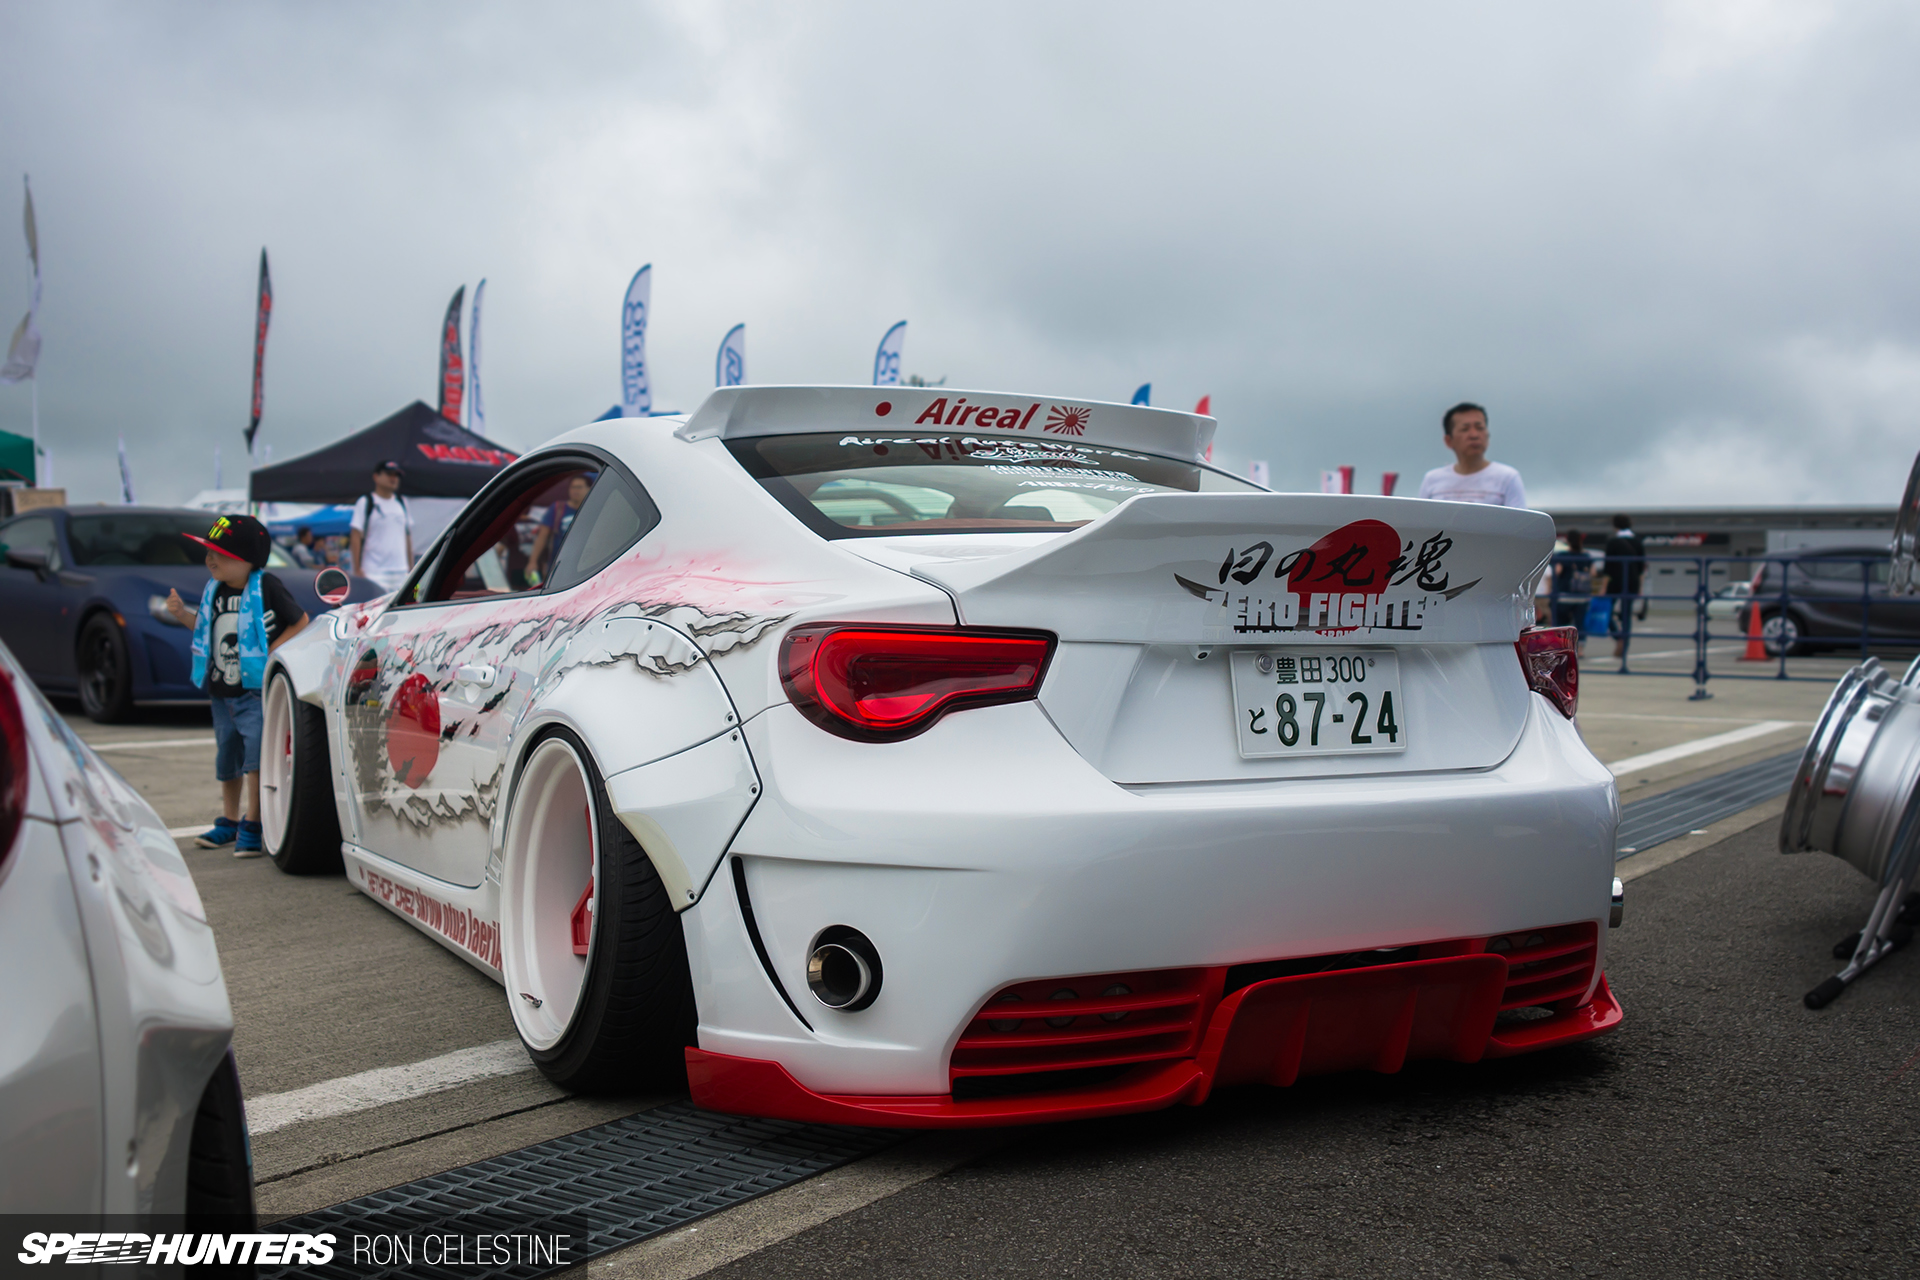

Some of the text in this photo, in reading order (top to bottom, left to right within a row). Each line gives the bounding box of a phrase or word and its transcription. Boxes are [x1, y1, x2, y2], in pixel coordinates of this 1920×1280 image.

[915, 398, 1041, 430] Aireal
[1218, 530, 1453, 591] 日の丸魂
[1202, 591, 1300, 627] ZERO
[1249, 691, 1399, 747] と 87-24
